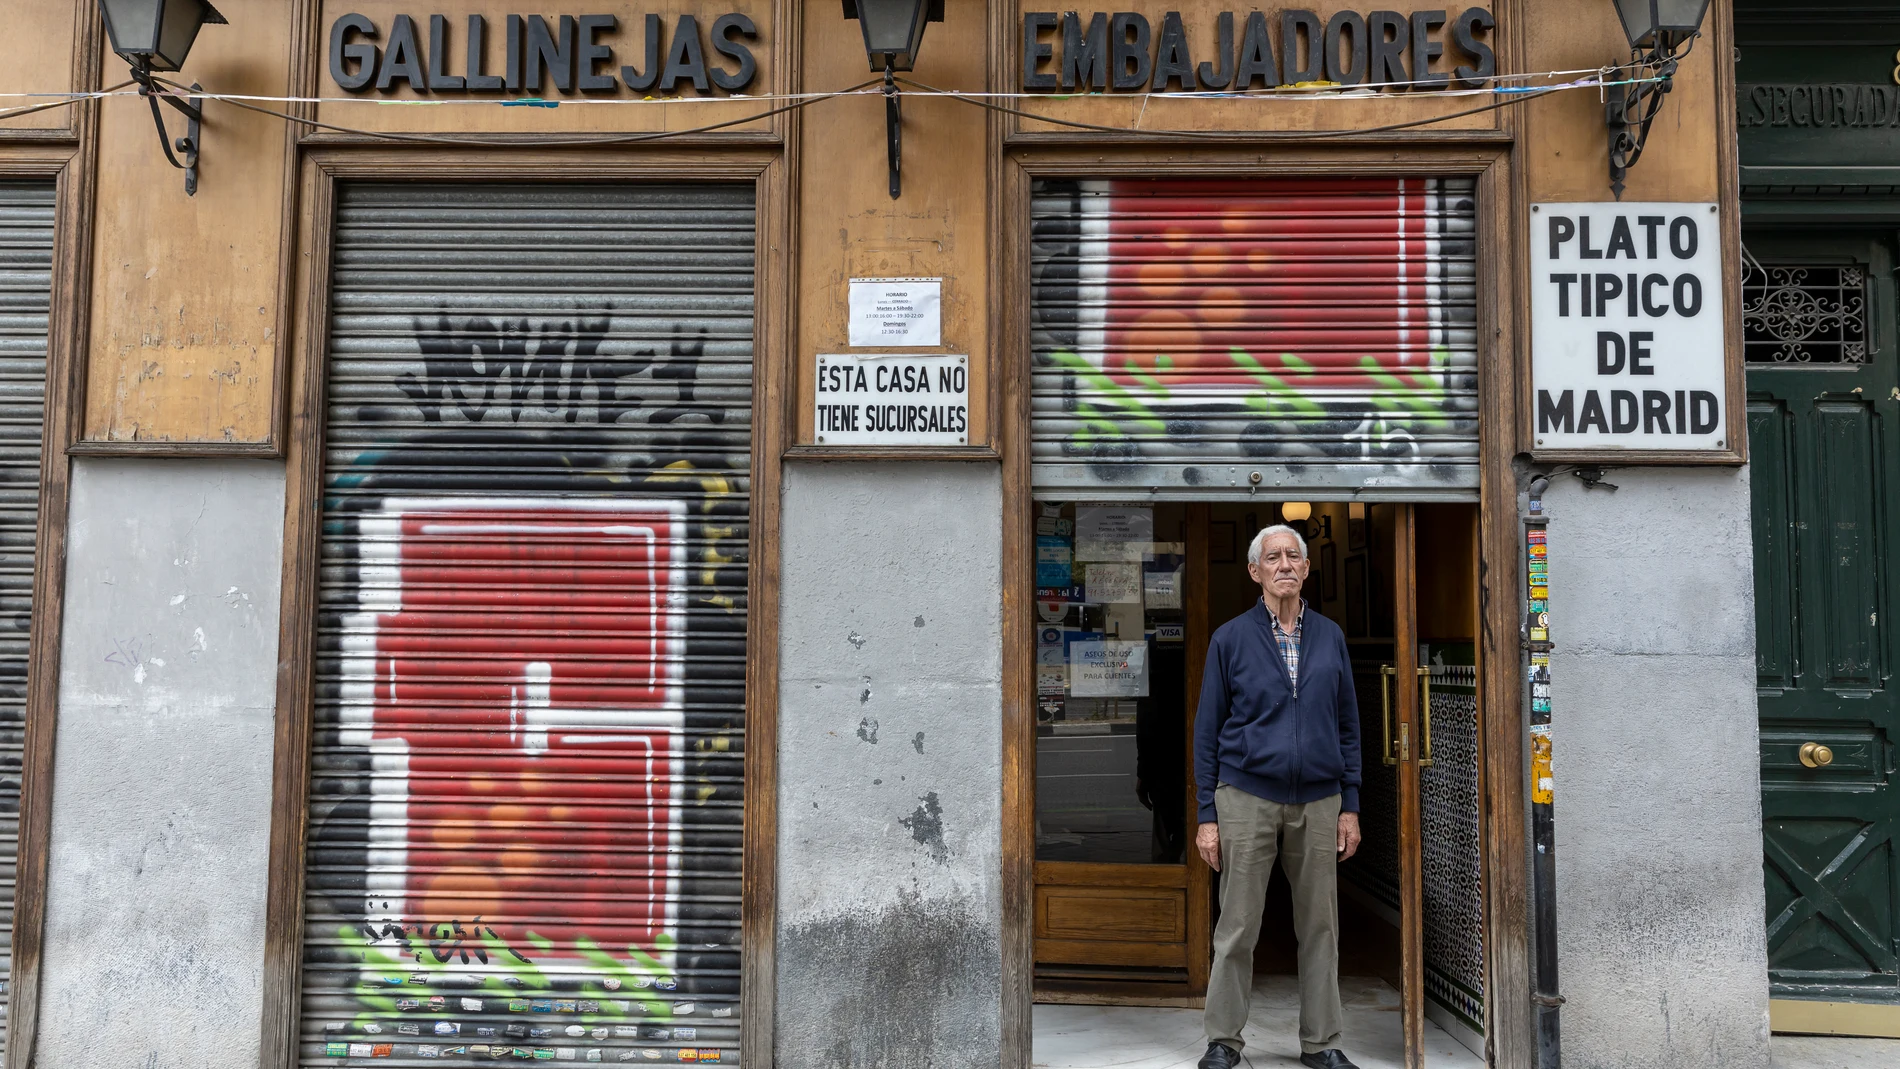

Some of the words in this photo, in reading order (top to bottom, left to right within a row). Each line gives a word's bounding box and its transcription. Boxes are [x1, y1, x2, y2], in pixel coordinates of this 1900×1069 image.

[329, 12, 757, 93] GALLINEJAS
[1023, 6, 1496, 91] EMBAJADORES
[1548, 215, 1698, 260] PLATO
[1550, 273, 1702, 317] TIPICO
[1597, 331, 1654, 375] DE
[818, 366, 868, 393] ESTA
[876, 366, 930, 393] CASA
[939, 366, 965, 393] NO
[818, 405, 859, 432] TIENE
[866, 405, 966, 433] SUCURSALES
[1538, 389, 1719, 435] MADRID
[1084, 650, 1107, 658] ASEOS
[1160, 628, 1181, 636] VISA
[1104, 672, 1136, 680] CLIENTES
